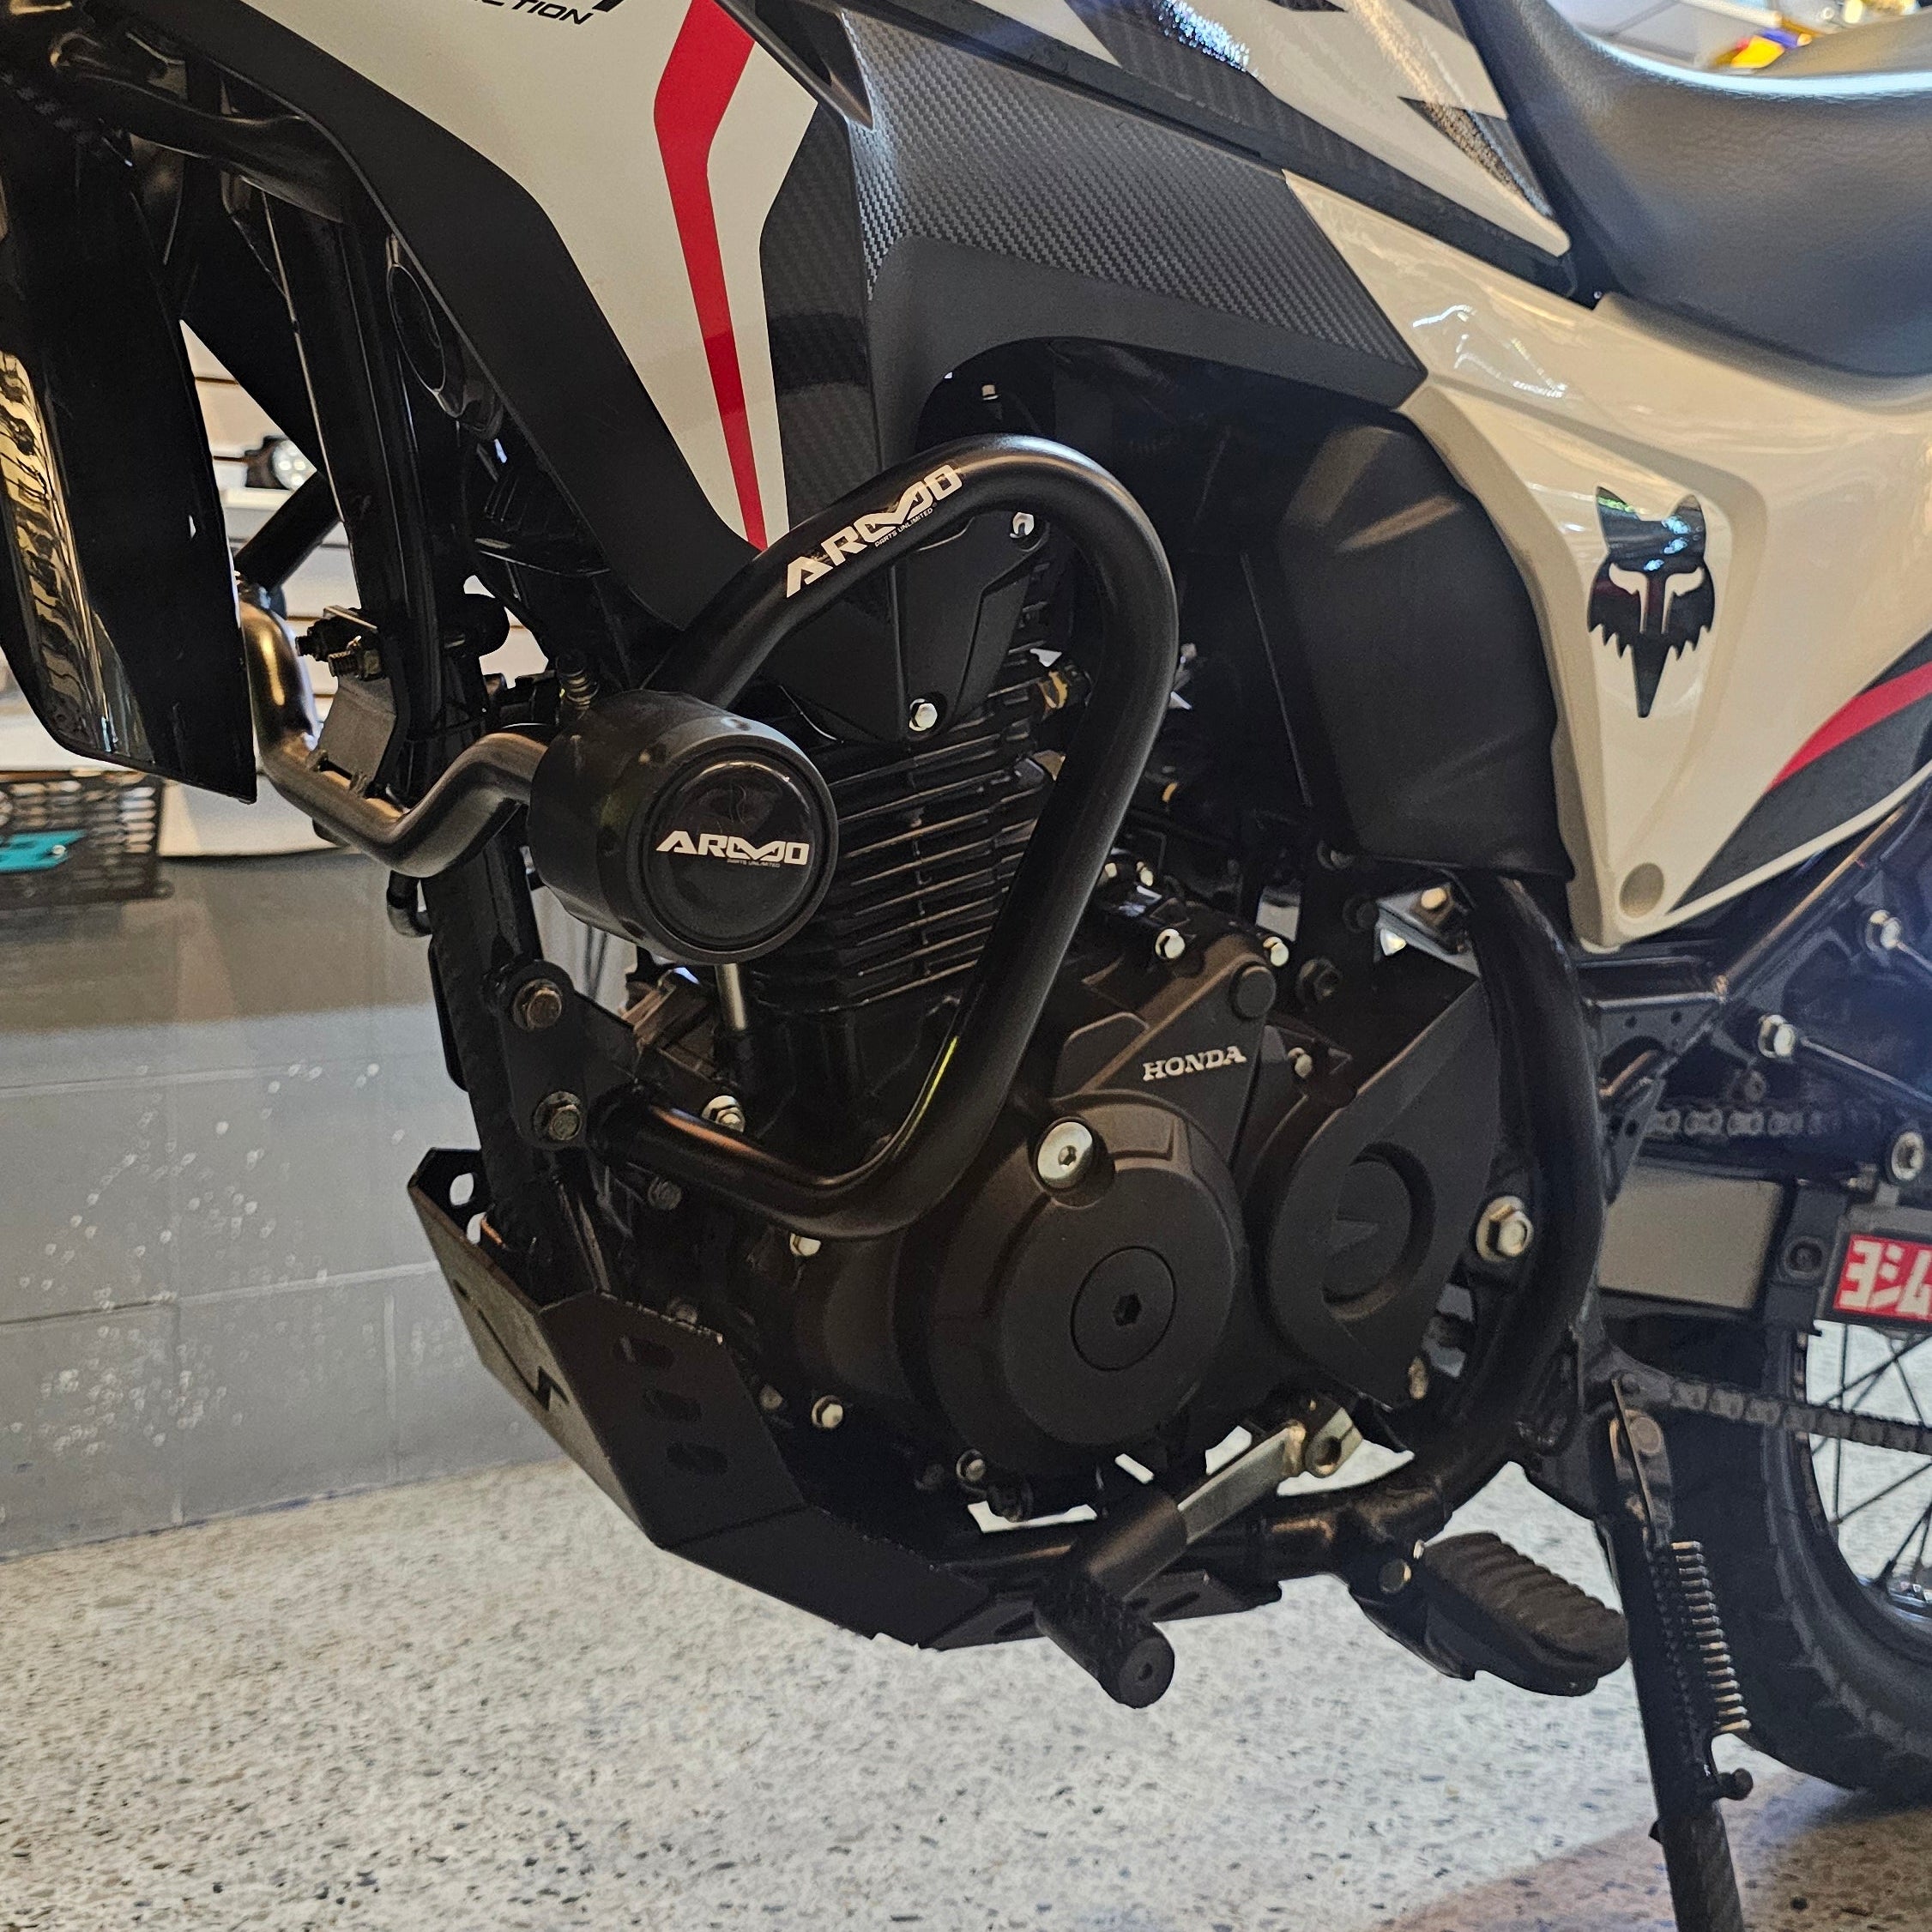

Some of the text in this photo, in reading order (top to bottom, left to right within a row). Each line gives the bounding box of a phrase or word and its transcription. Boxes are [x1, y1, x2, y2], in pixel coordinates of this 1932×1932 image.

[874, 508, 933, 547] PARTS UNLIMITED
[1142, 1046, 1247, 1082] HONDA
